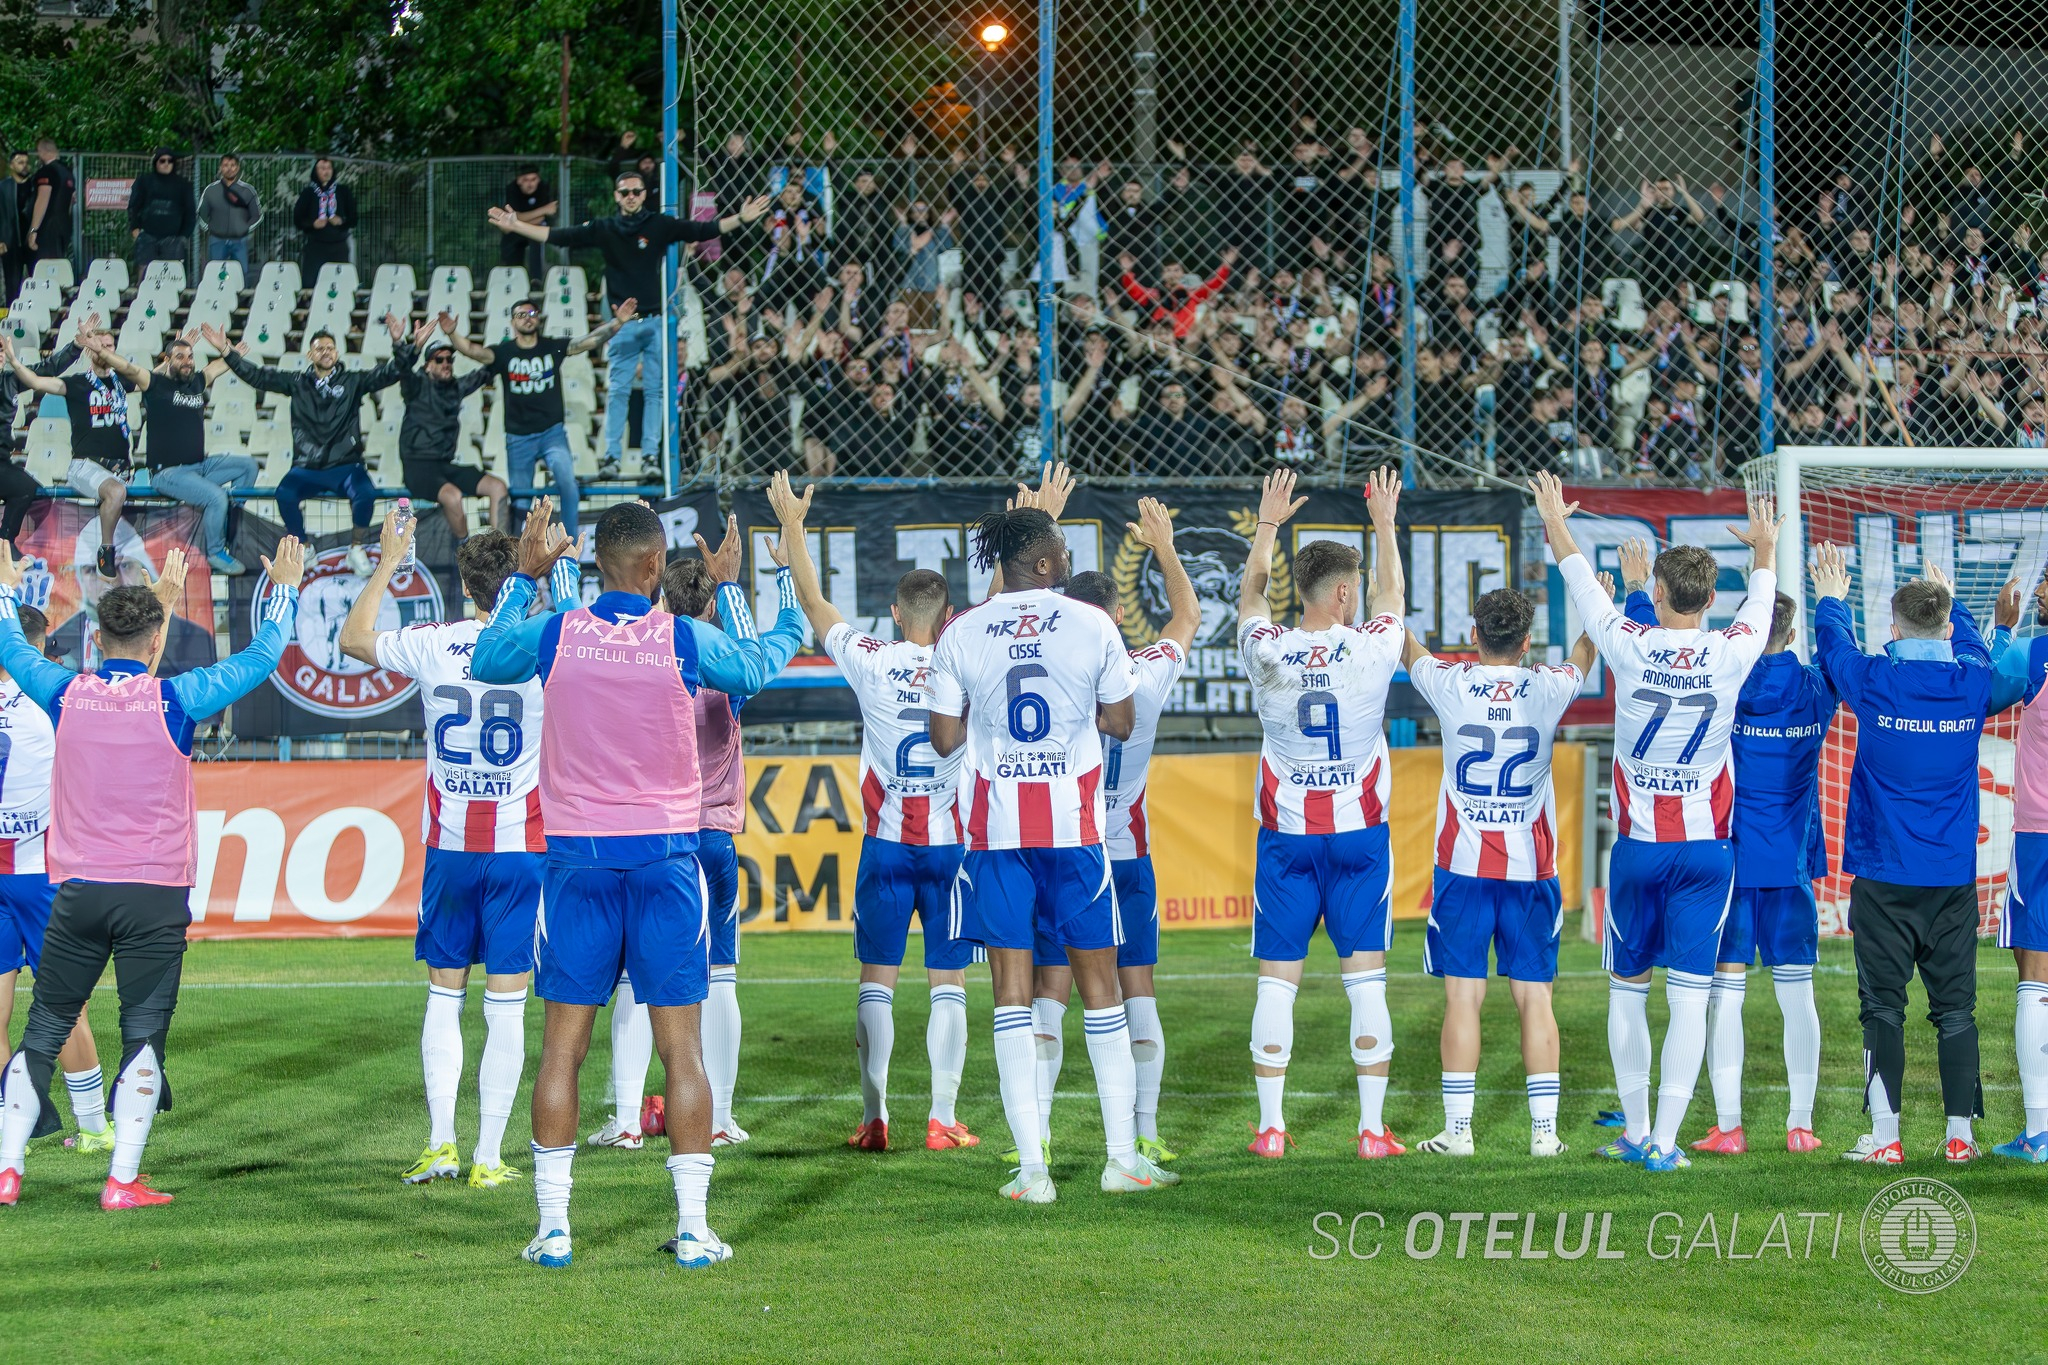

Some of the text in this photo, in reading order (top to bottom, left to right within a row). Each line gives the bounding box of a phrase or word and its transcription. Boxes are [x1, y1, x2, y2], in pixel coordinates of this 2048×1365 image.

[577, 646, 630, 664] OTELUL
[1008, 640, 1042, 660] CISSÉ
[294, 663, 397, 704] GALAT
[1301, 674, 1330, 688] STAN
[1642, 670, 1713, 690] ANDRONACHE
[75, 698, 122, 712] OTELUL
[125, 701, 170, 712] GALAI
[1006, 663, 1050, 743] 6
[1487, 707, 1512, 722] BANI
[1877, 715, 1976, 733] SC OTELUL GALATI
[433, 685, 523, 767] 28
[1298, 691, 1342, 761] 9
[1631, 689, 1718, 765] 77
[1786, 722, 1822, 738] GALATI
[896, 708, 936, 778] 2
[1456, 724, 1540, 797] 22
